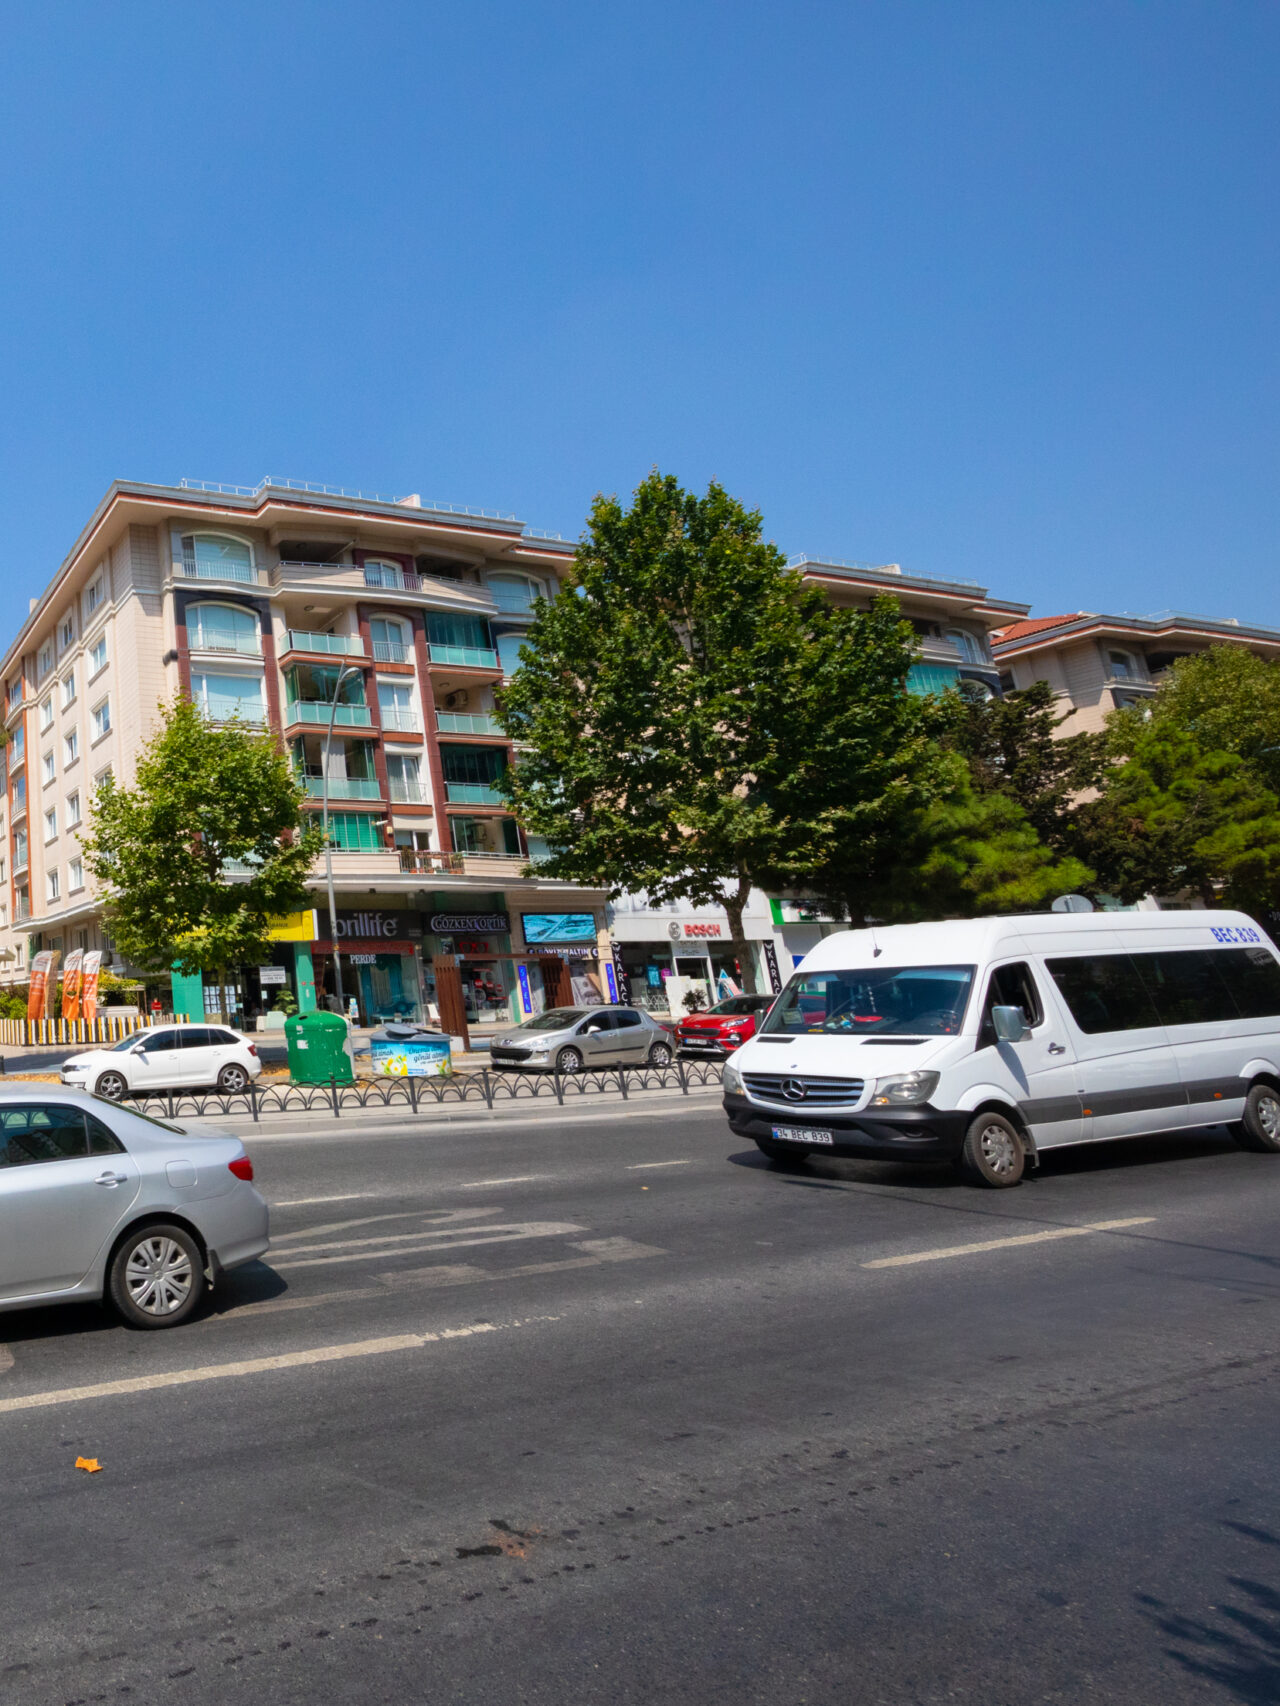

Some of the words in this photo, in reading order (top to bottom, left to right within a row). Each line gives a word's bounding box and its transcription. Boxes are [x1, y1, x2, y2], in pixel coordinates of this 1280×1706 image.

[683, 923, 722, 937] BOSCH
[1209, 927, 1238, 943] BEC
[1234, 927, 1260, 943] 839
[568, 948, 589, 956] ALTIN
[350, 954, 377, 965] PERDE
[778, 1128, 788, 1138] 34
[791, 1129, 808, 1140] BEC
[811, 1131, 830, 1142] 839
